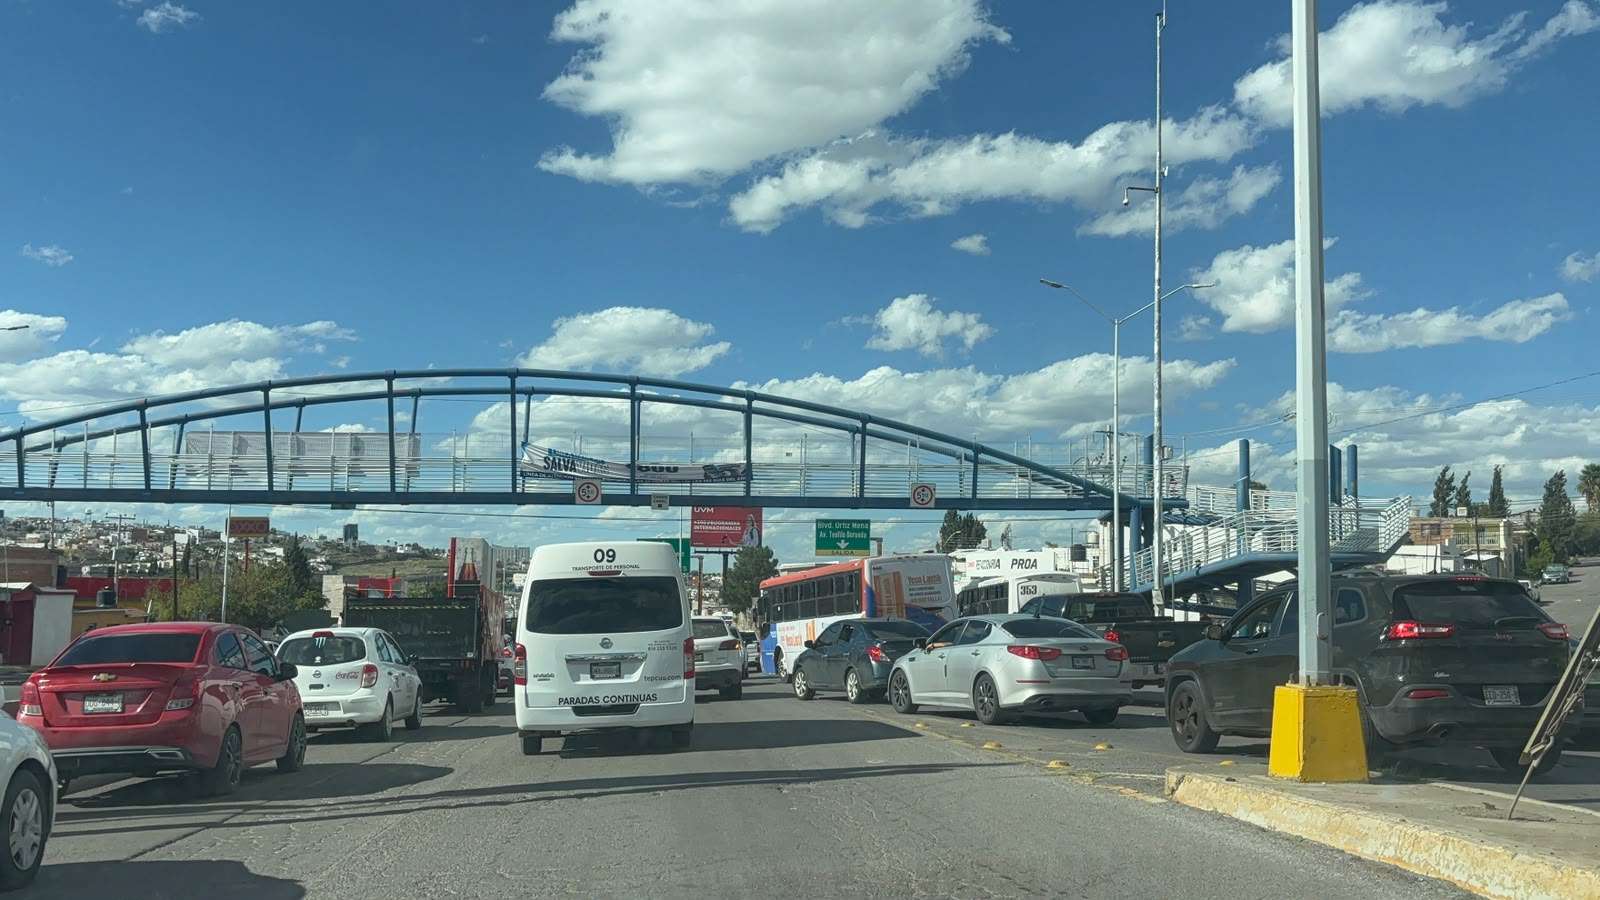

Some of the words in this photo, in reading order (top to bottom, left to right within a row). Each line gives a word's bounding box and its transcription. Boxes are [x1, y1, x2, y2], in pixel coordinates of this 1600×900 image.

[543, 456, 577, 472] SALVA
[834, 521, 850, 529] Ortiz
[851, 521, 869, 529] Mena
[819, 530, 828, 538] Av.
[593, 548, 616, 563] 09
[1010, 558, 1038, 570] PROA
[1020, 585, 1037, 595] 353
[335, 671, 360, 680] Coca-Cola
[558, 696, 600, 705] PARADAS
[602, 693, 658, 704] CONTINUAS
